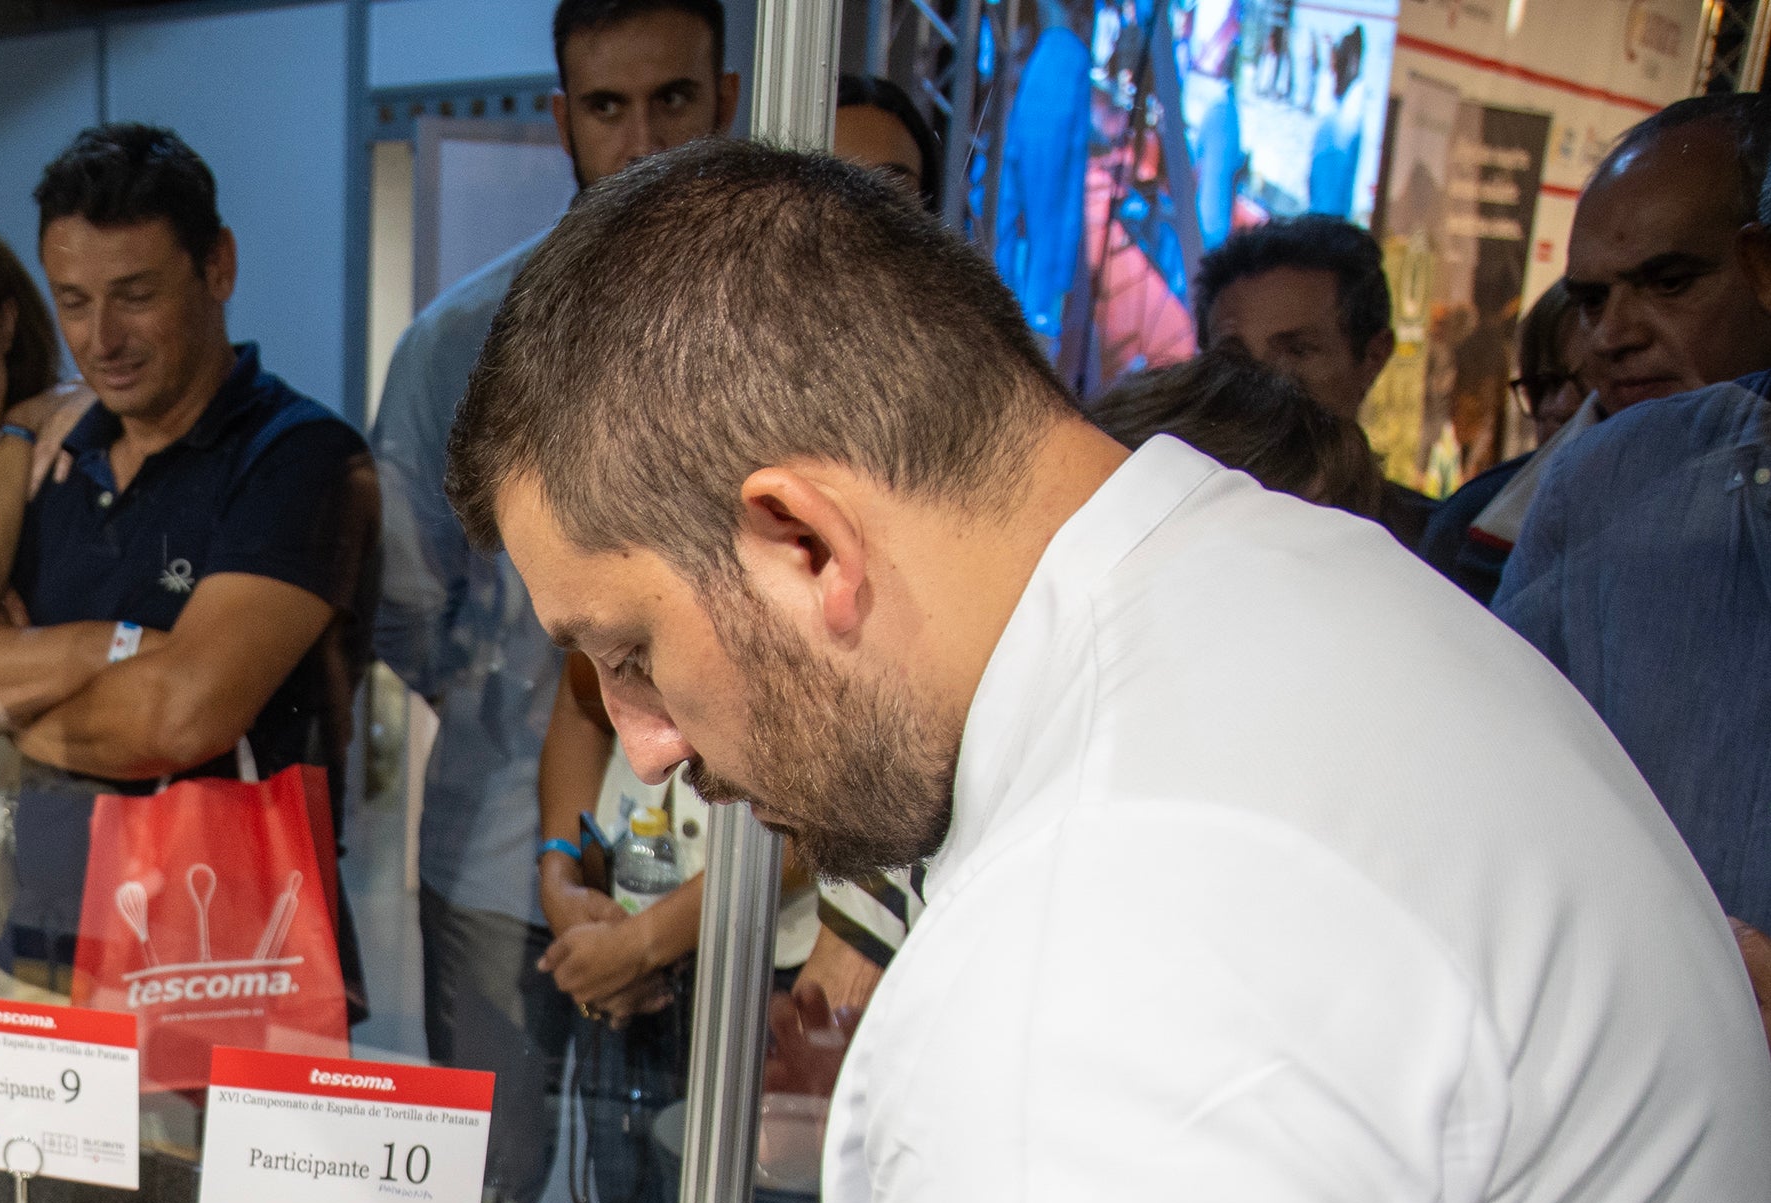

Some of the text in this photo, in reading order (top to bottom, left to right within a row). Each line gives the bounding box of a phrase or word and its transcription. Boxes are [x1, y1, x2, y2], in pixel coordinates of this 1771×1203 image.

[61, 1068, 82, 1104] 9
[219, 1091, 480, 1127] XVI Campeonato de España de Tortilla de Patatas
[249, 1141, 432, 1186] Participante 10
